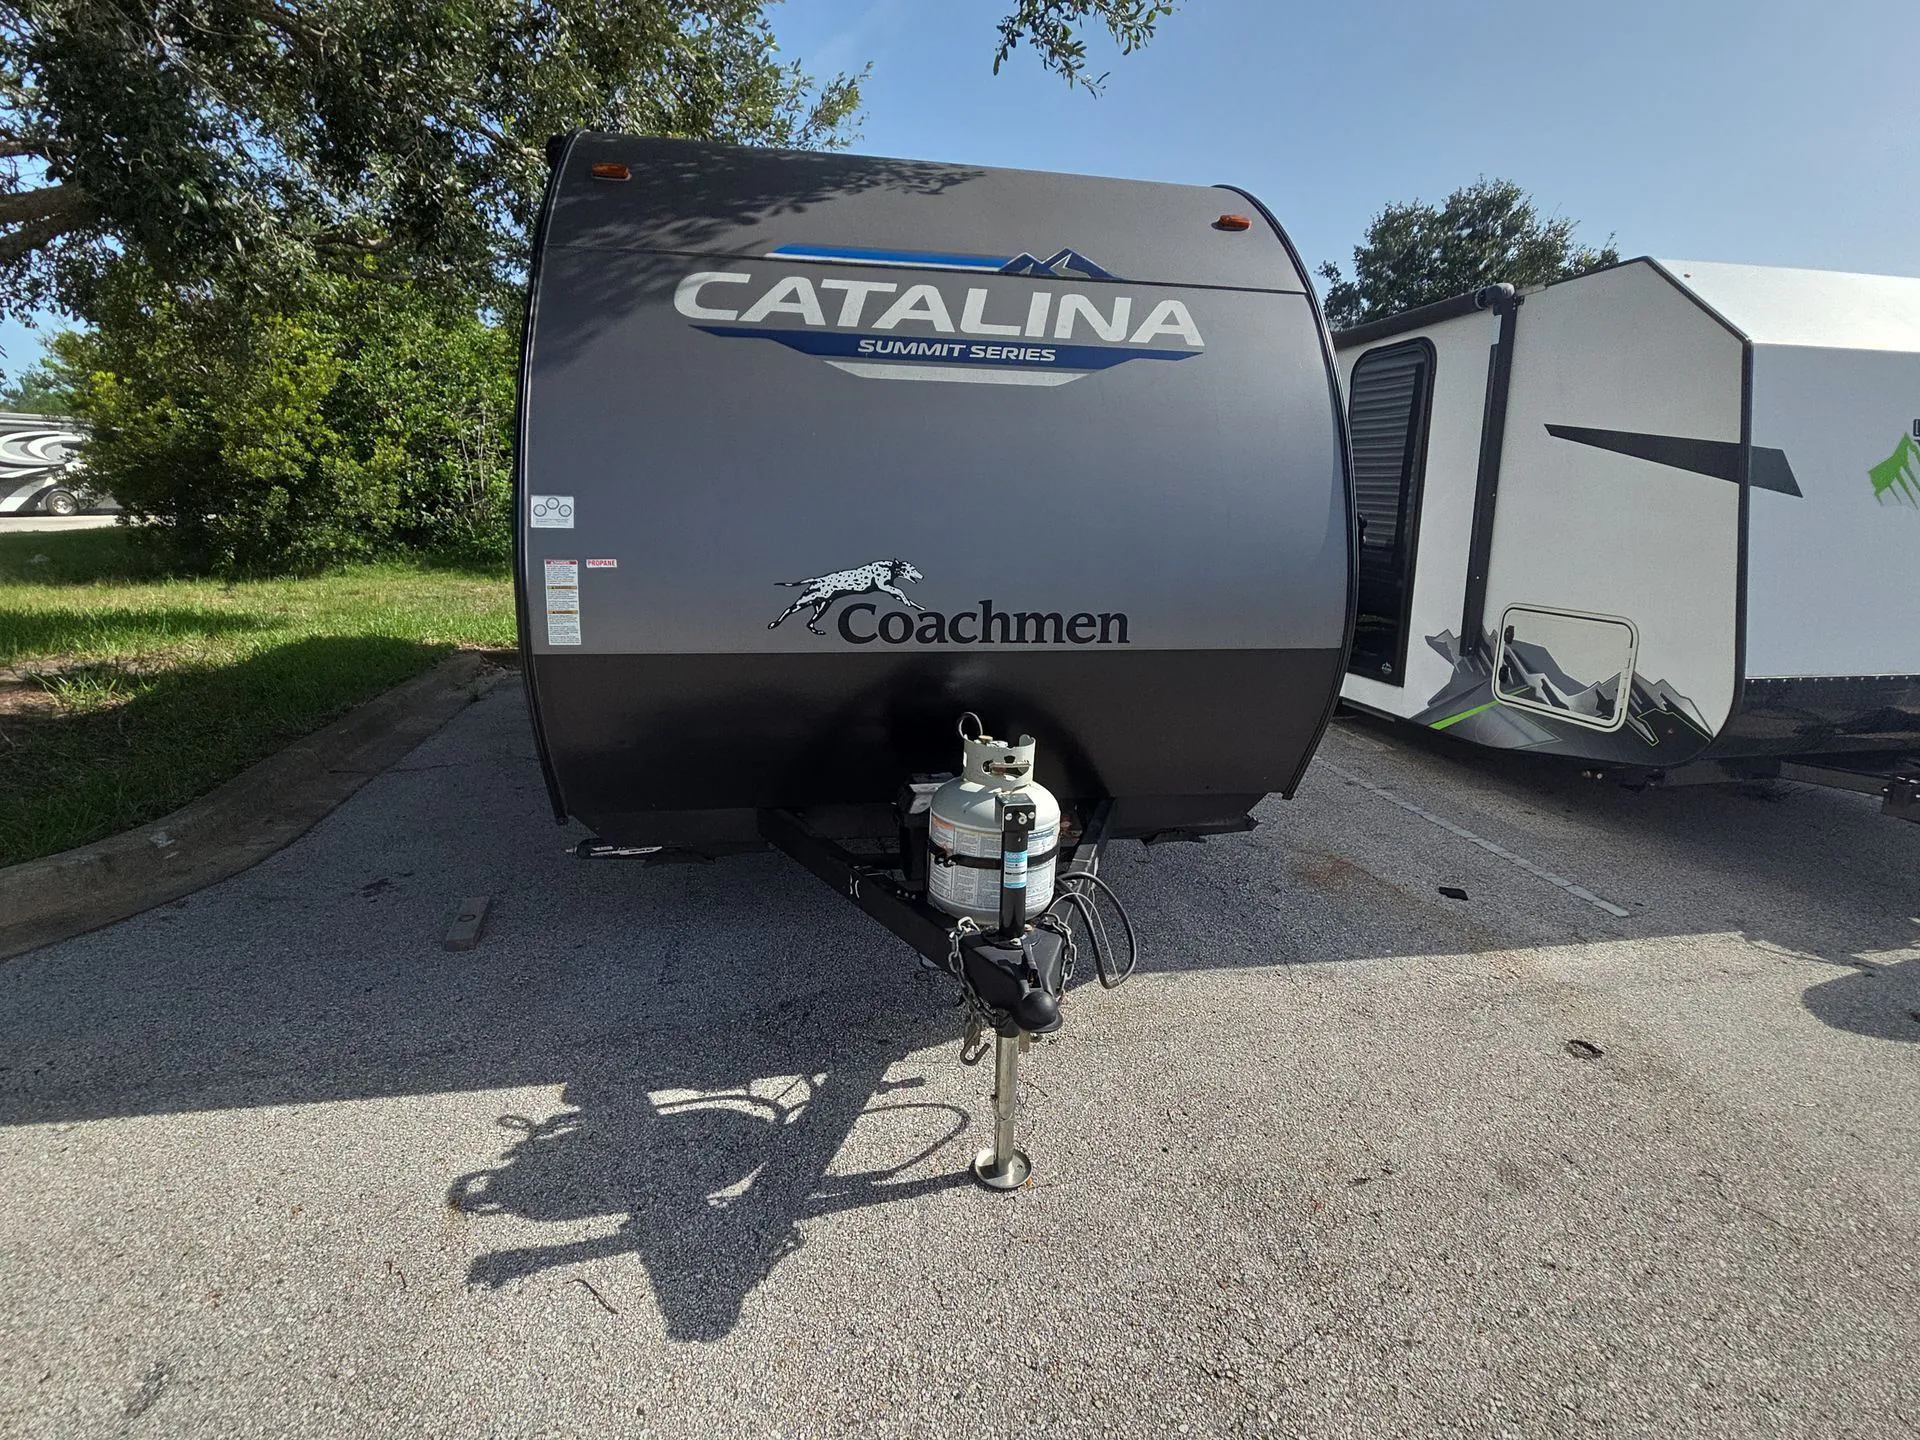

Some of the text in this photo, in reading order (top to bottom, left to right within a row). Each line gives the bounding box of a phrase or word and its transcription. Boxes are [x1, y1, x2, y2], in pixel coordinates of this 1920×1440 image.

[674, 272, 1205, 347] CATALINA
[857, 339, 1057, 362] SUMMIT SERIES
[587, 559, 615, 567] PROPANE
[837, 600, 1130, 645] Coachmen
